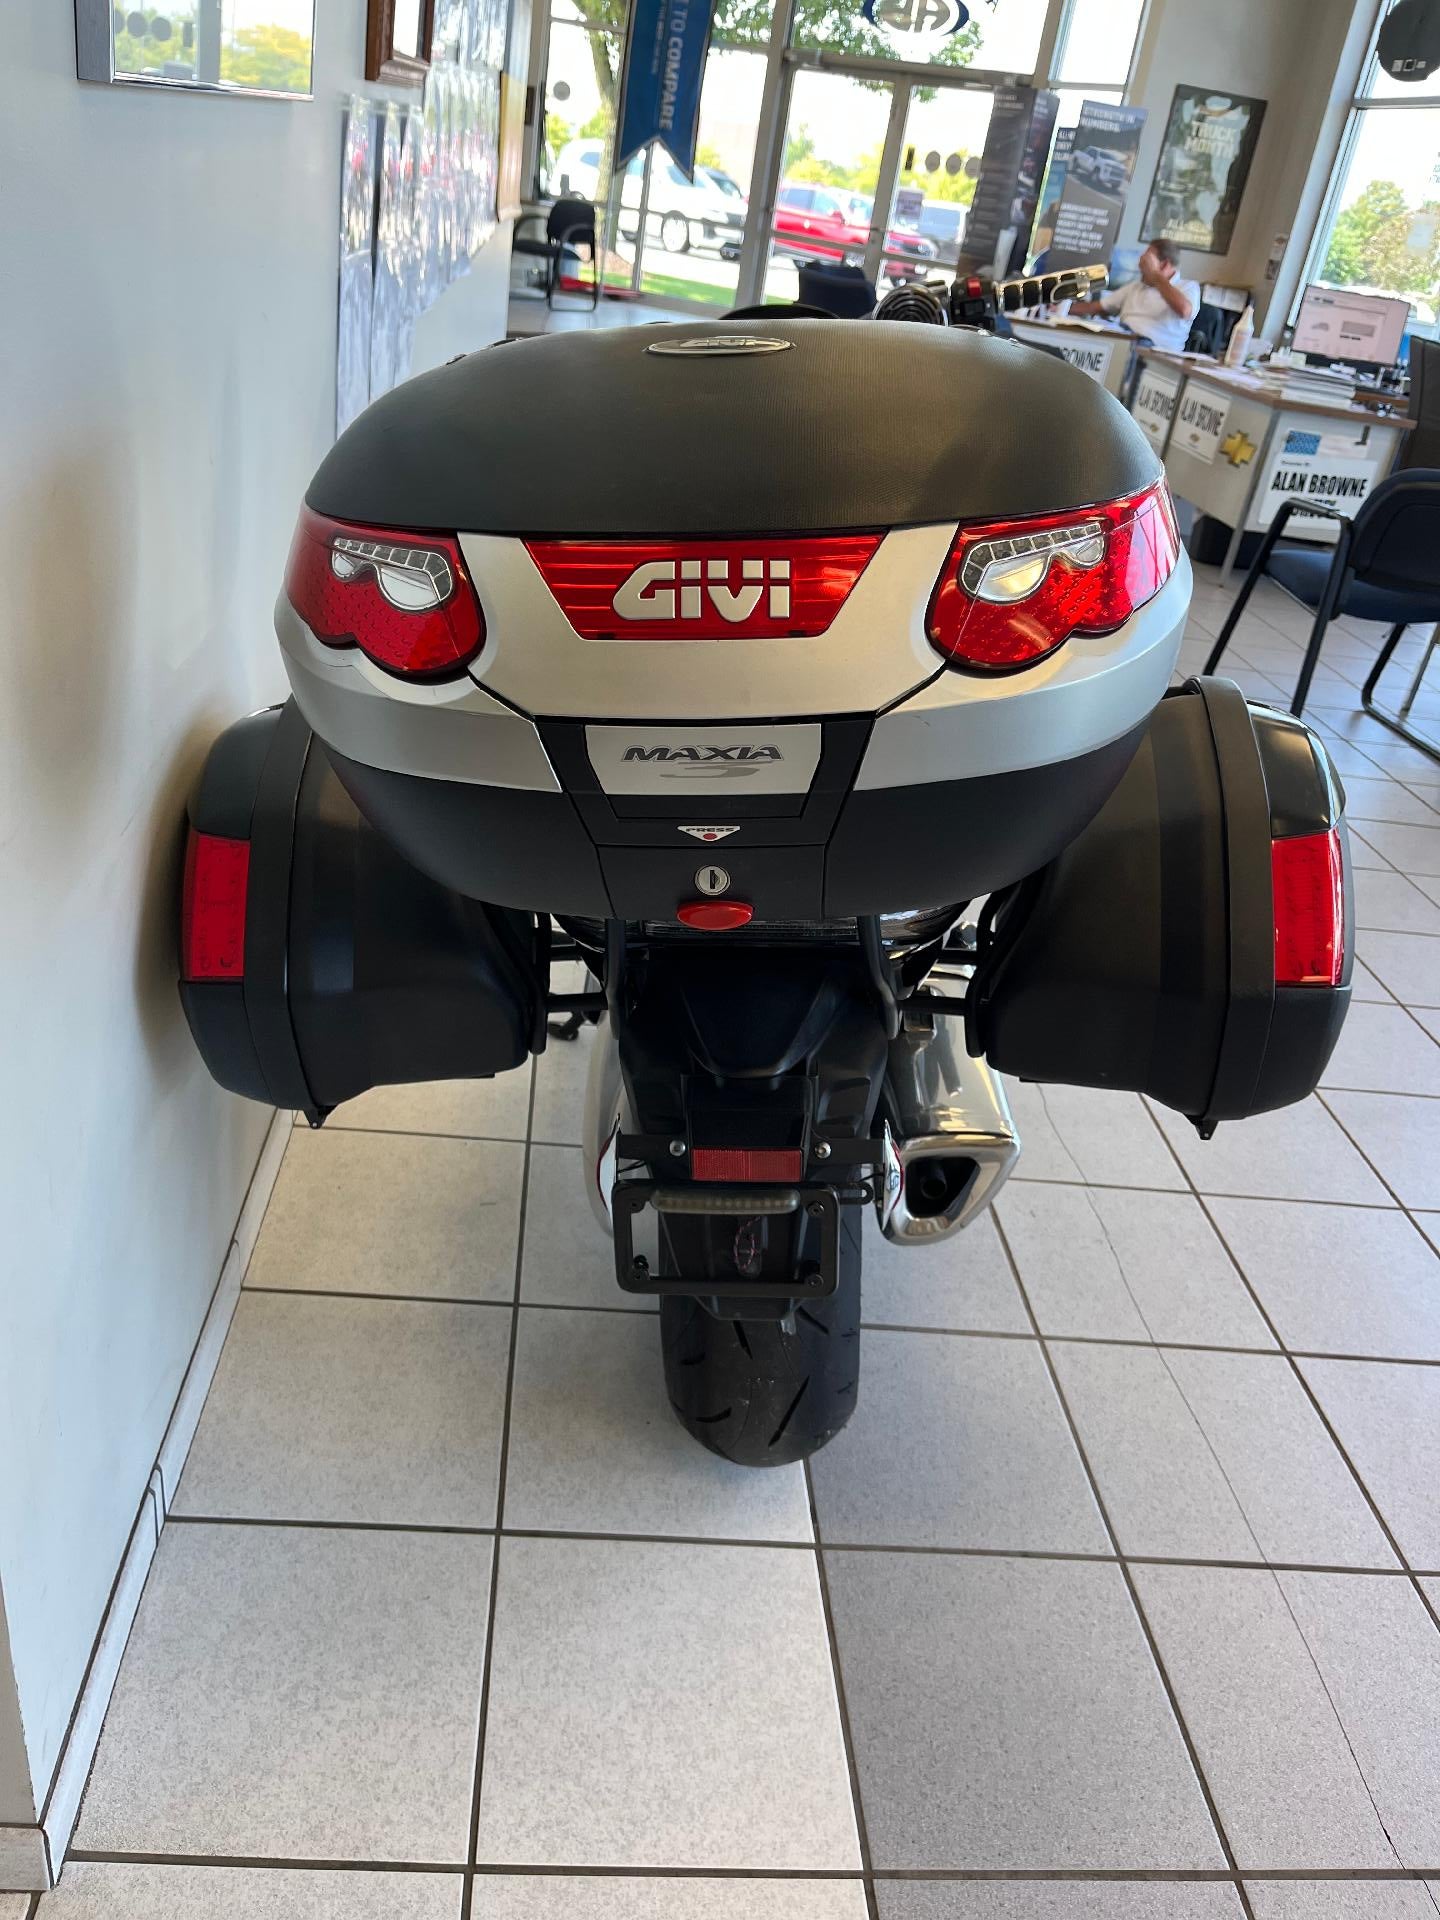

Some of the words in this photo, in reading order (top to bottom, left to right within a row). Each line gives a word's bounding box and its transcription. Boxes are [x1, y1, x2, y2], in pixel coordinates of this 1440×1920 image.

[670, 9, 688, 33] TO
[658, 37, 683, 130] COMPARE
[1191, 120, 1237, 143] TRUCK
[1183, 138, 1235, 160] MONTH
[1062, 347, 1104, 372] ROWNE
[1271, 470, 1308, 493] ALAN
[1308, 474, 1369, 497] BROWNE
[612, 559, 791, 623] GIVI
[621, 744, 784, 762] MAXIA
[685, 826, 735, 834] PRESS
